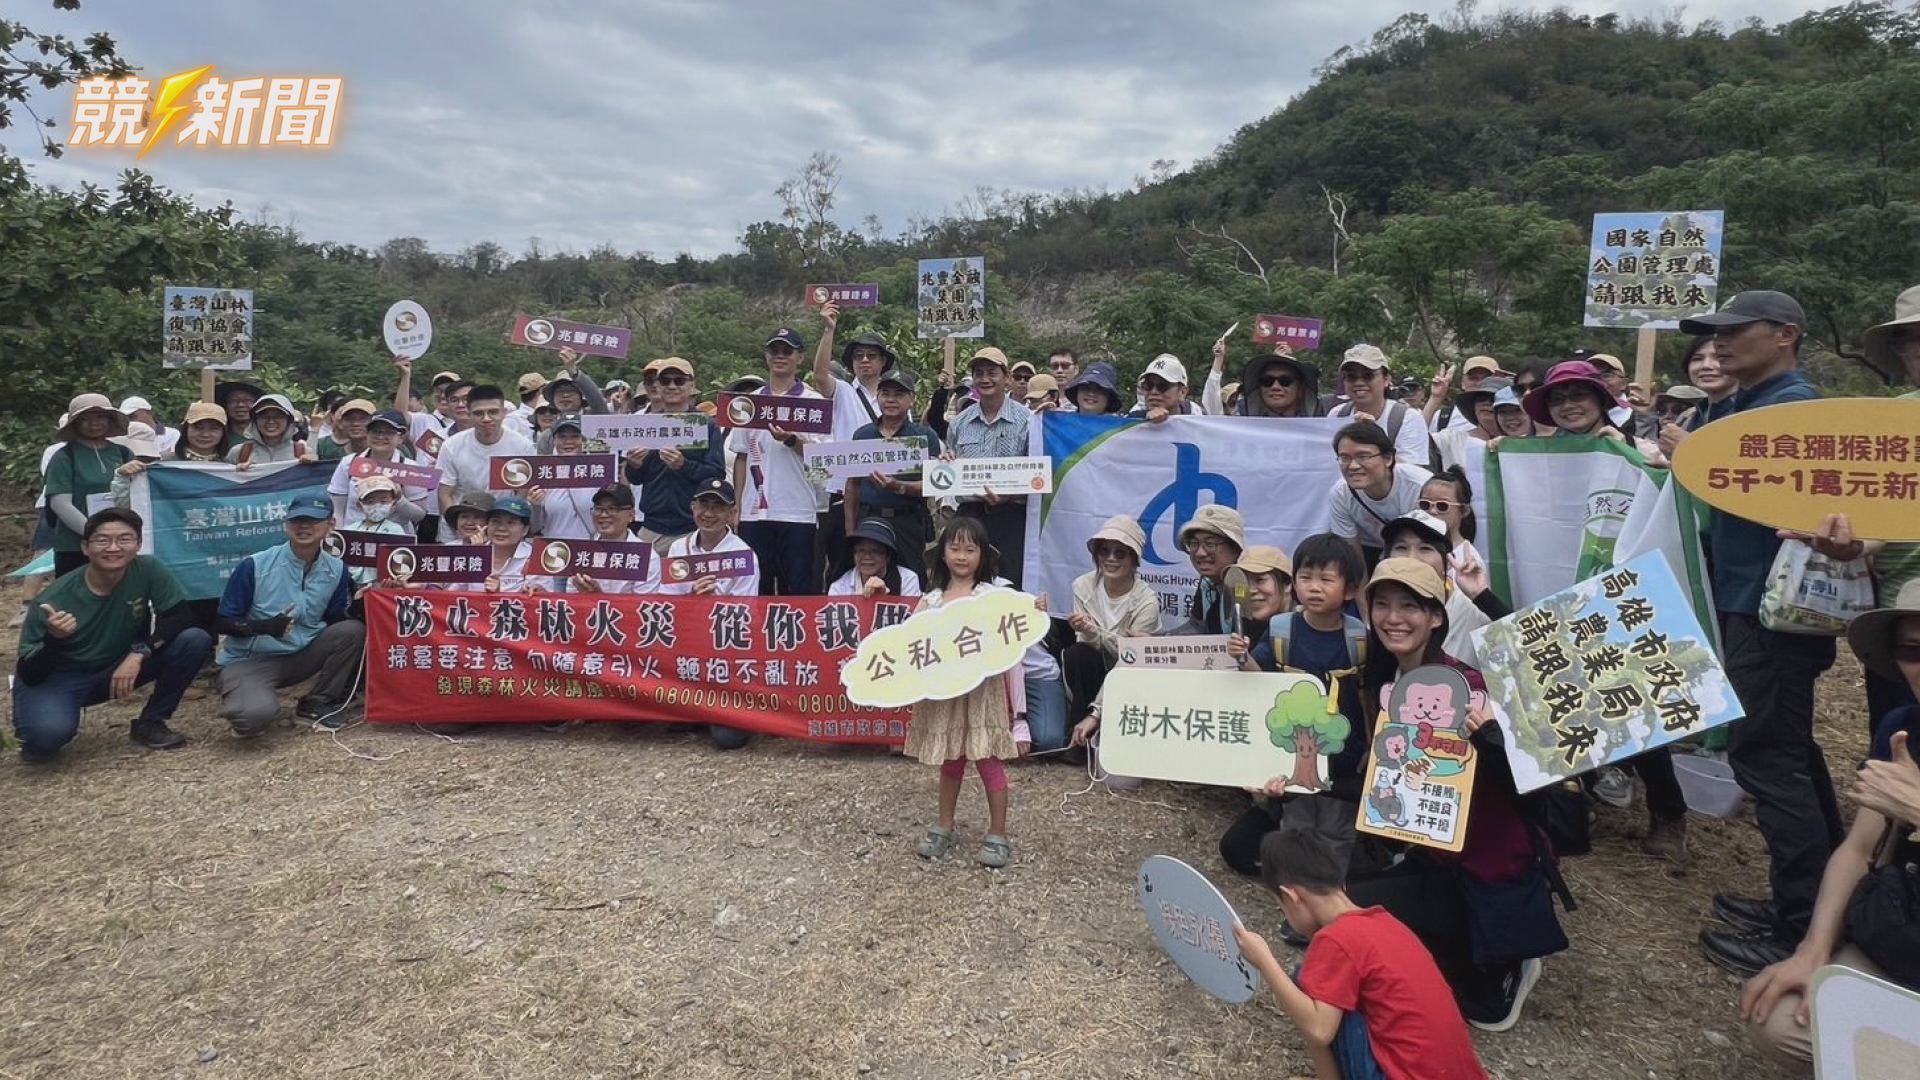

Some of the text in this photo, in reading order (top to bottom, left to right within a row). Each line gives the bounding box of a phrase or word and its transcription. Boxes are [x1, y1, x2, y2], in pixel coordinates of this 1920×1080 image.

[1606, 228, 1706, 248] 國家自然
[1594, 256, 1714, 275] 公園管理處
[921, 270, 981, 286] 兆豐金融
[170, 294, 249, 312] 臺灣山林
[938, 288, 965, 305] 集團
[1593, 283, 1709, 306] 請跟我來
[921, 306, 981, 323] 請跟我來
[169, 315, 247, 334] 復育協會
[169, 336, 247, 354] 請跟我來
[557, 329, 619, 349] 兆豐保險
[760, 405, 824, 424] 兆豐保險
[596, 426, 694, 438] 高雄市政府農業局
[811, 449, 921, 467] 國家自然公園管理處
[1739, 434, 1920, 463] 餵食獼猴將
[538, 464, 605, 479] 兆豐保險
[183, 530, 229, 541] Taiwan
[420, 556, 483, 572] 兆豐保險
[575, 551, 641, 570] 兆豐保險
[695, 557, 746, 573] 兆豐保險
[394, 595, 677, 650] 防止森林火災
[866, 612, 1030, 682] 公私合作
[1601, 567, 1703, 732] 高雄市政府
[388, 644, 514, 671] 掃墓要注意
[528, 649, 662, 680] 勿隨意引火
[676, 655, 819, 687] 鞭炮不亂放
[1567, 609, 1645, 721] 農業局
[1517, 606, 1600, 766] 請跟我來
[1118, 704, 1251, 745] 樹木保護
[1417, 798, 1452, 816] 不餵食
